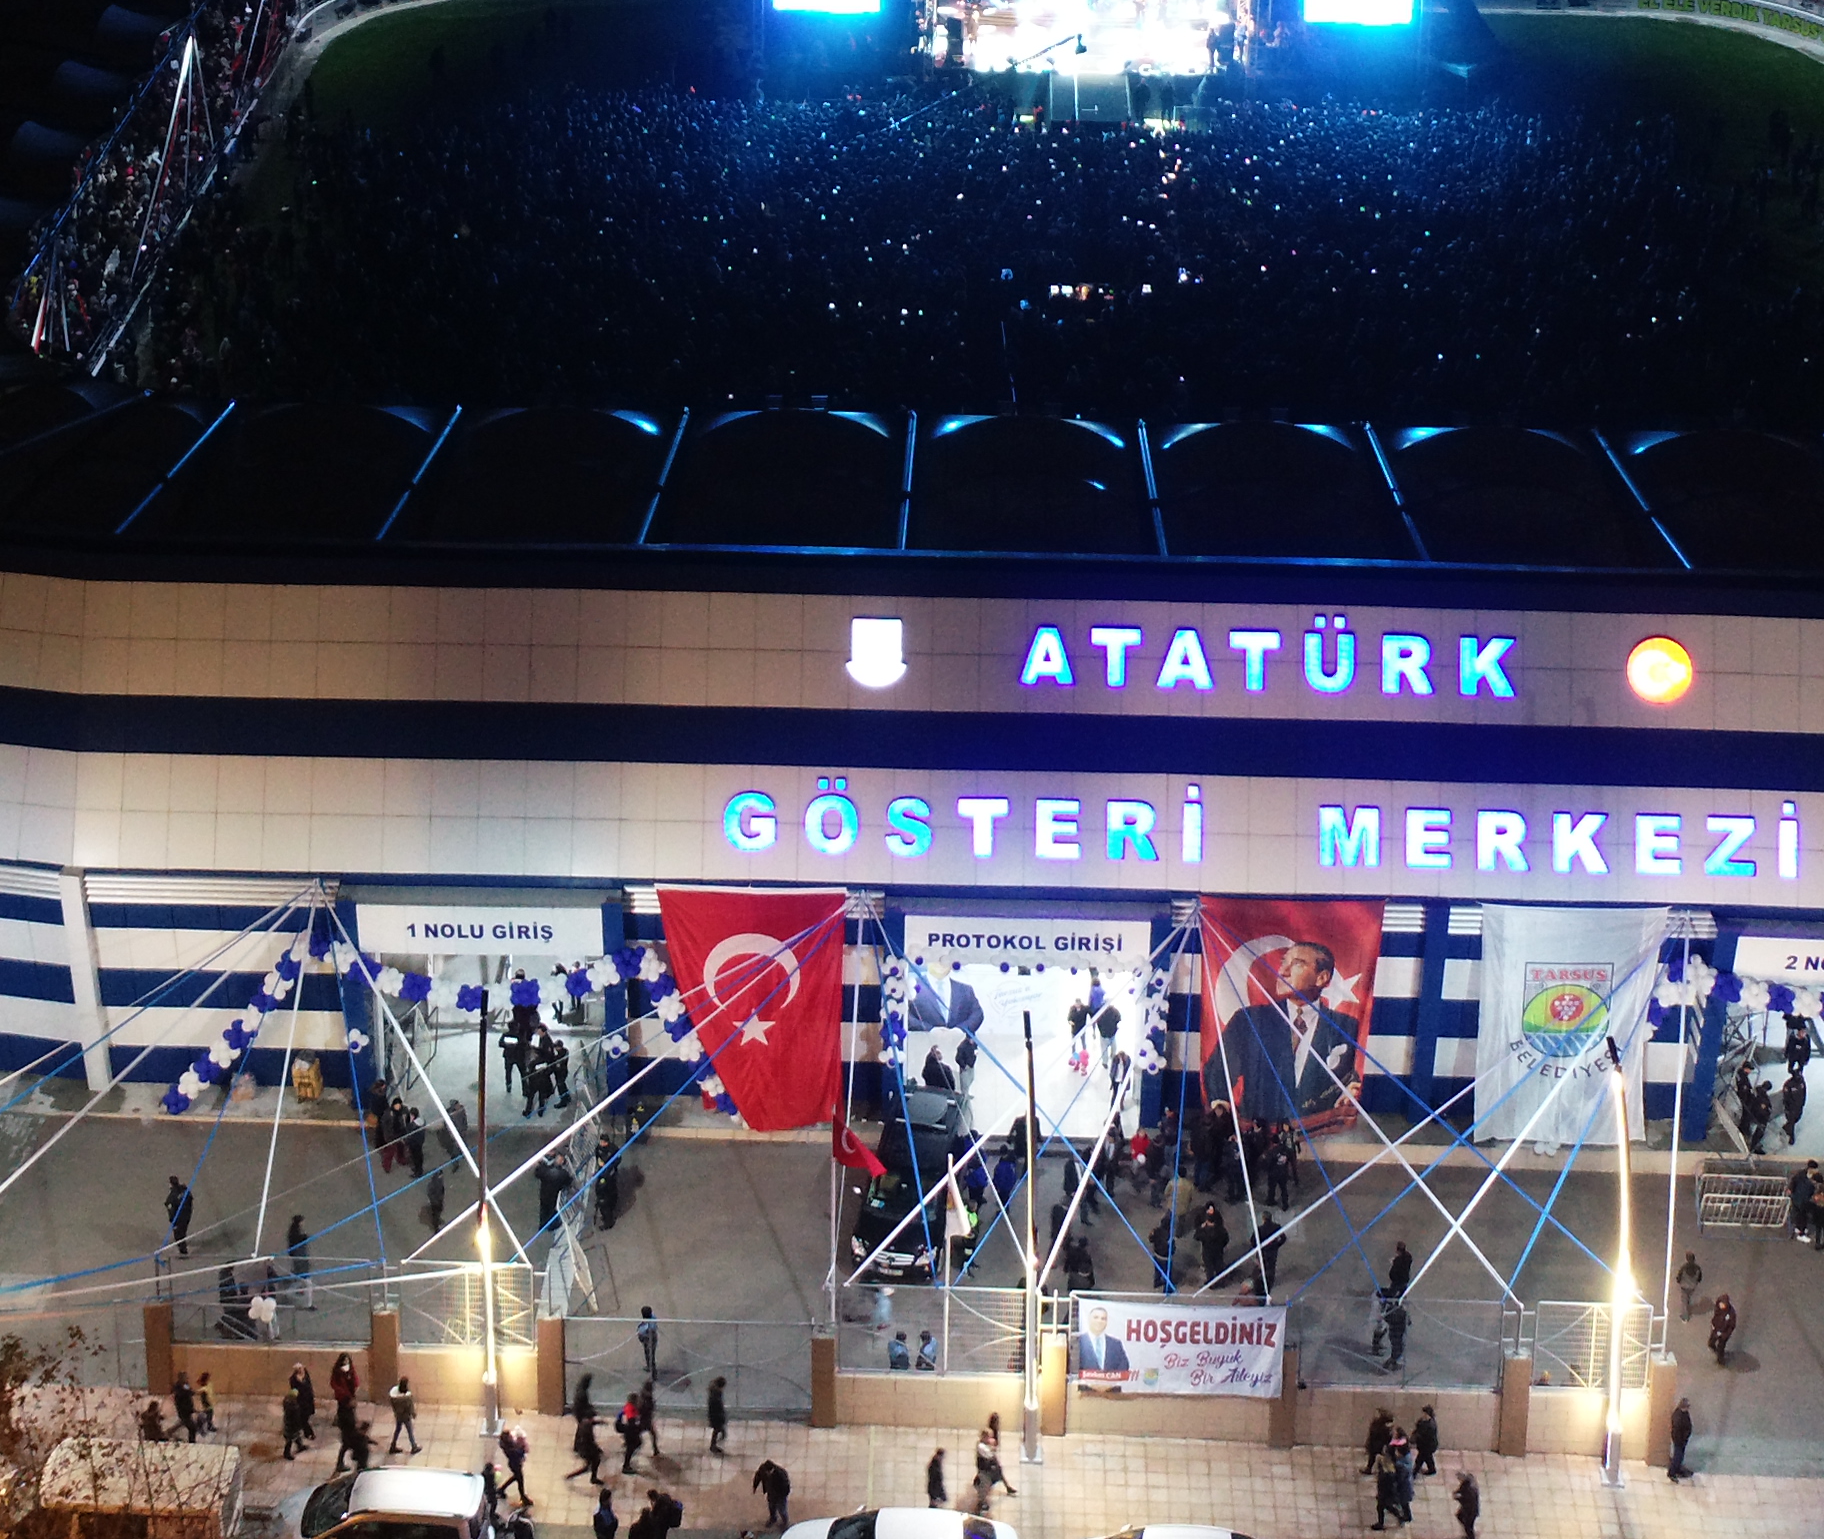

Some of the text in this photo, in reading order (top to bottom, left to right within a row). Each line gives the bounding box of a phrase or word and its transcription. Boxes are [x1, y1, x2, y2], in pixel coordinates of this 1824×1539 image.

[1020, 616, 1517, 700] ATATÜRK
[722, 778, 1801, 881] GÖSTERİ MERKEZİ
[406, 921, 554, 943] 1 NOLU GİRİŞ
[928, 932, 1123, 954] PROTOKOL GİRİŞİ
[1531, 968, 1607, 981] TARSUS
[1785, 955, 1798, 972] 2
[1126, 1316, 1278, 1349] HOŞGELDİNİZ
[1164, 1353, 1189, 1369] Biz
[1190, 1369, 1214, 1386] Bir
